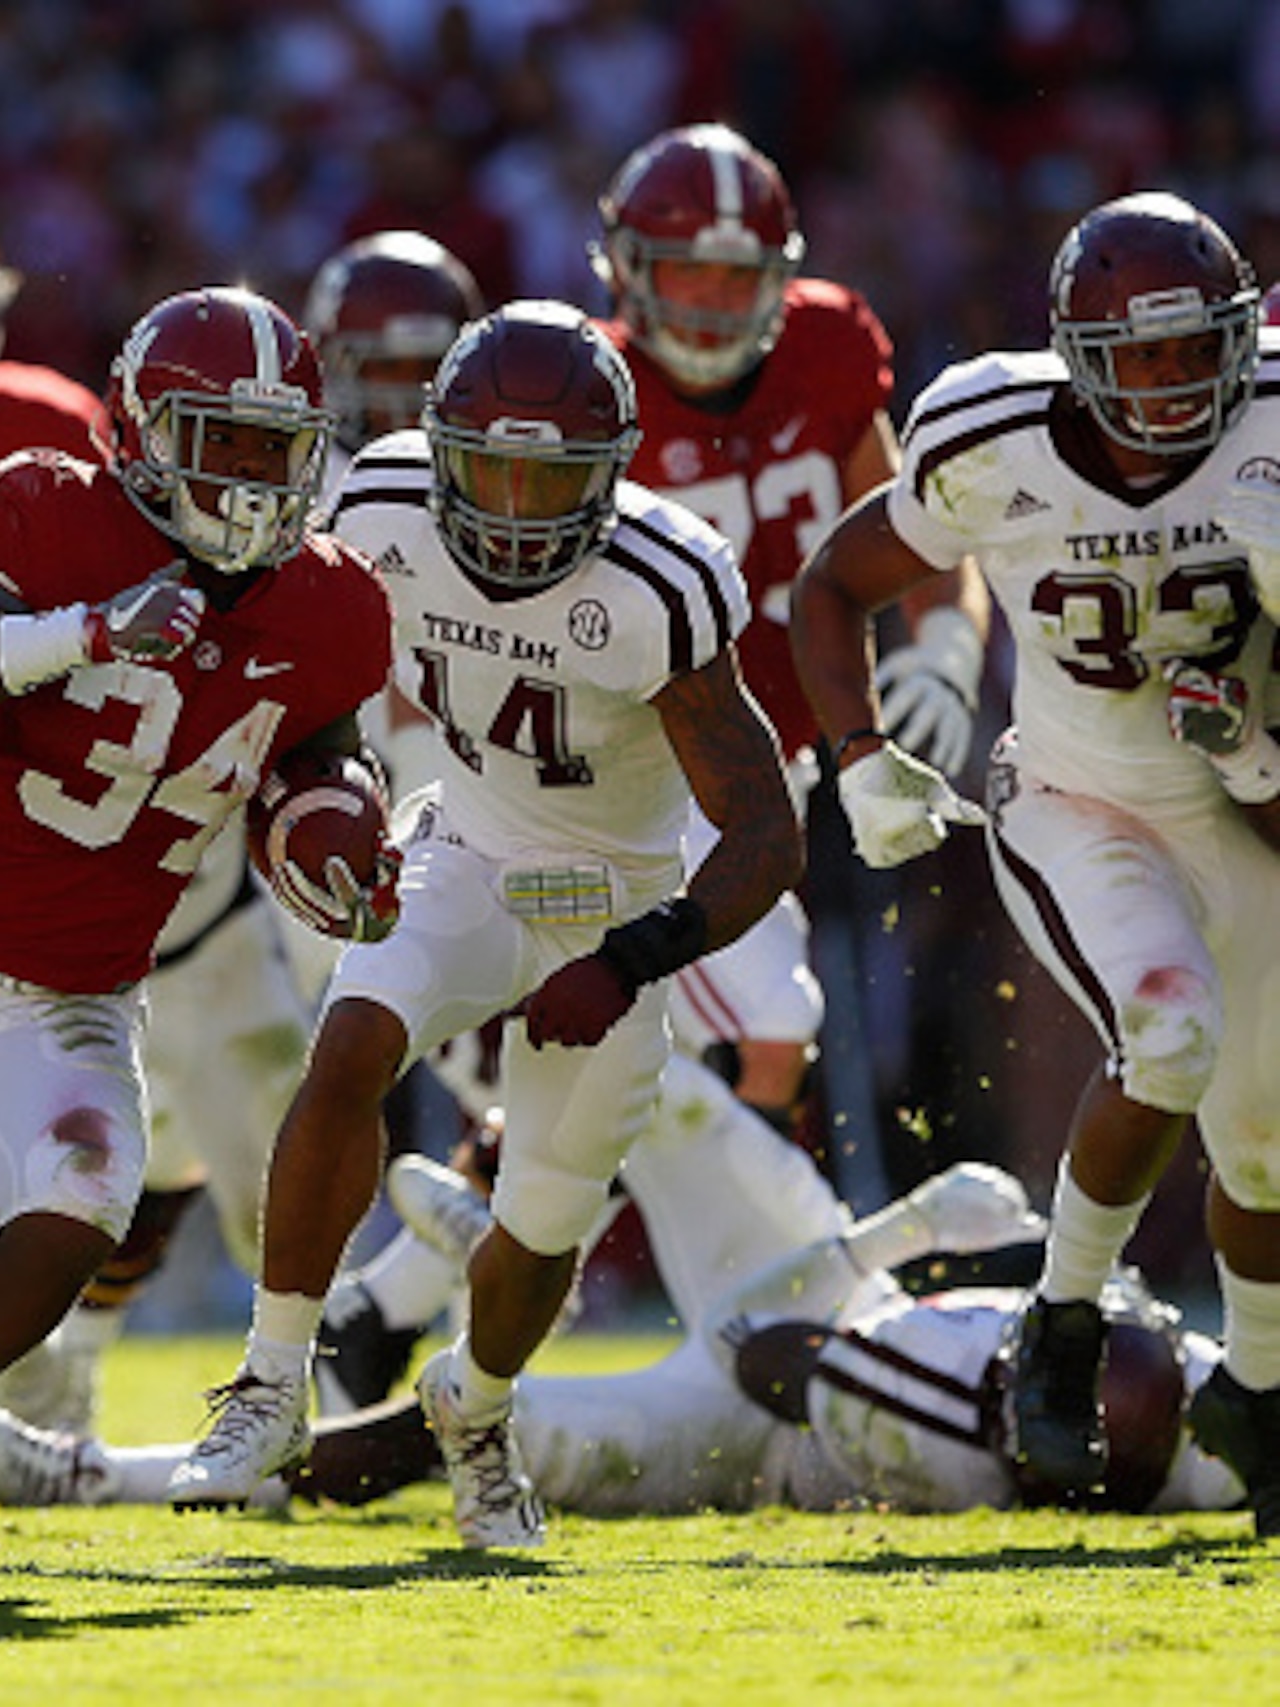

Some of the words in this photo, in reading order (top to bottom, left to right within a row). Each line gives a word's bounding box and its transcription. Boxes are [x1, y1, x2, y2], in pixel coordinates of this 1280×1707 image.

[1064, 528, 1161, 561] TEXAS
[422, 611, 504, 656] TEXAS
[410, 646, 595, 787] 14
[16, 658, 287, 875] 34
